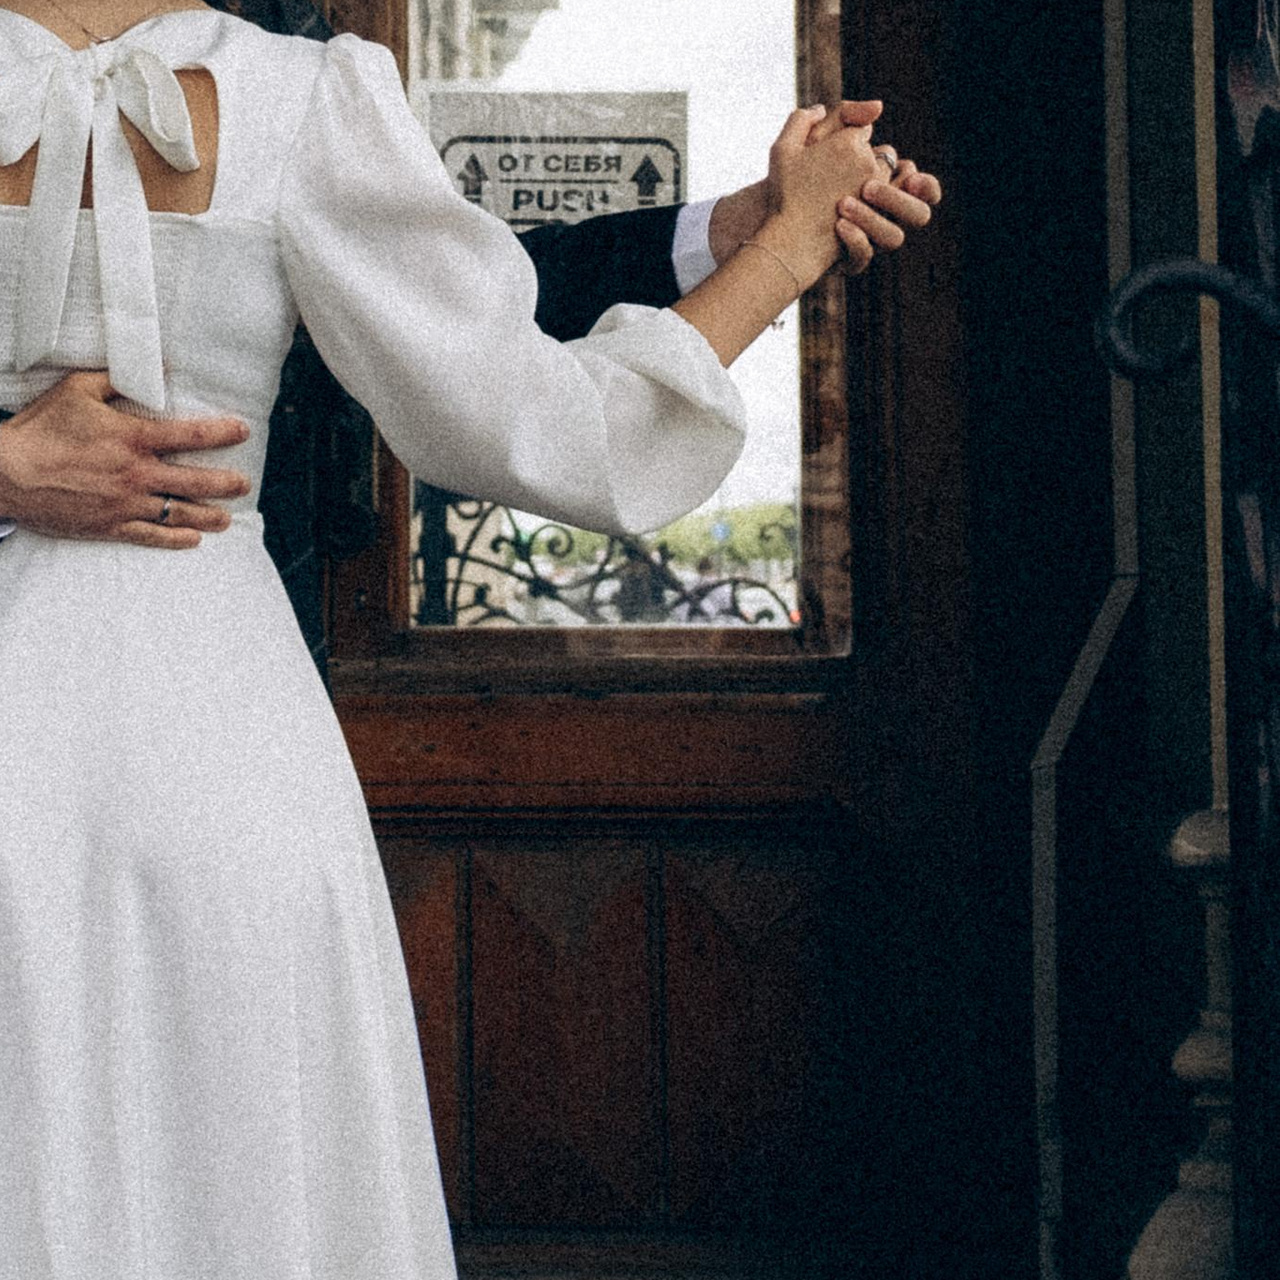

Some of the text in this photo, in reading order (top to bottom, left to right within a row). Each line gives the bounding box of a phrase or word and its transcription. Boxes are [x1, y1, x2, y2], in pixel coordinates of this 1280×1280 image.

[498, 153, 622, 174] ОТ СЕБЯ
[512, 189, 611, 213] PUSH
